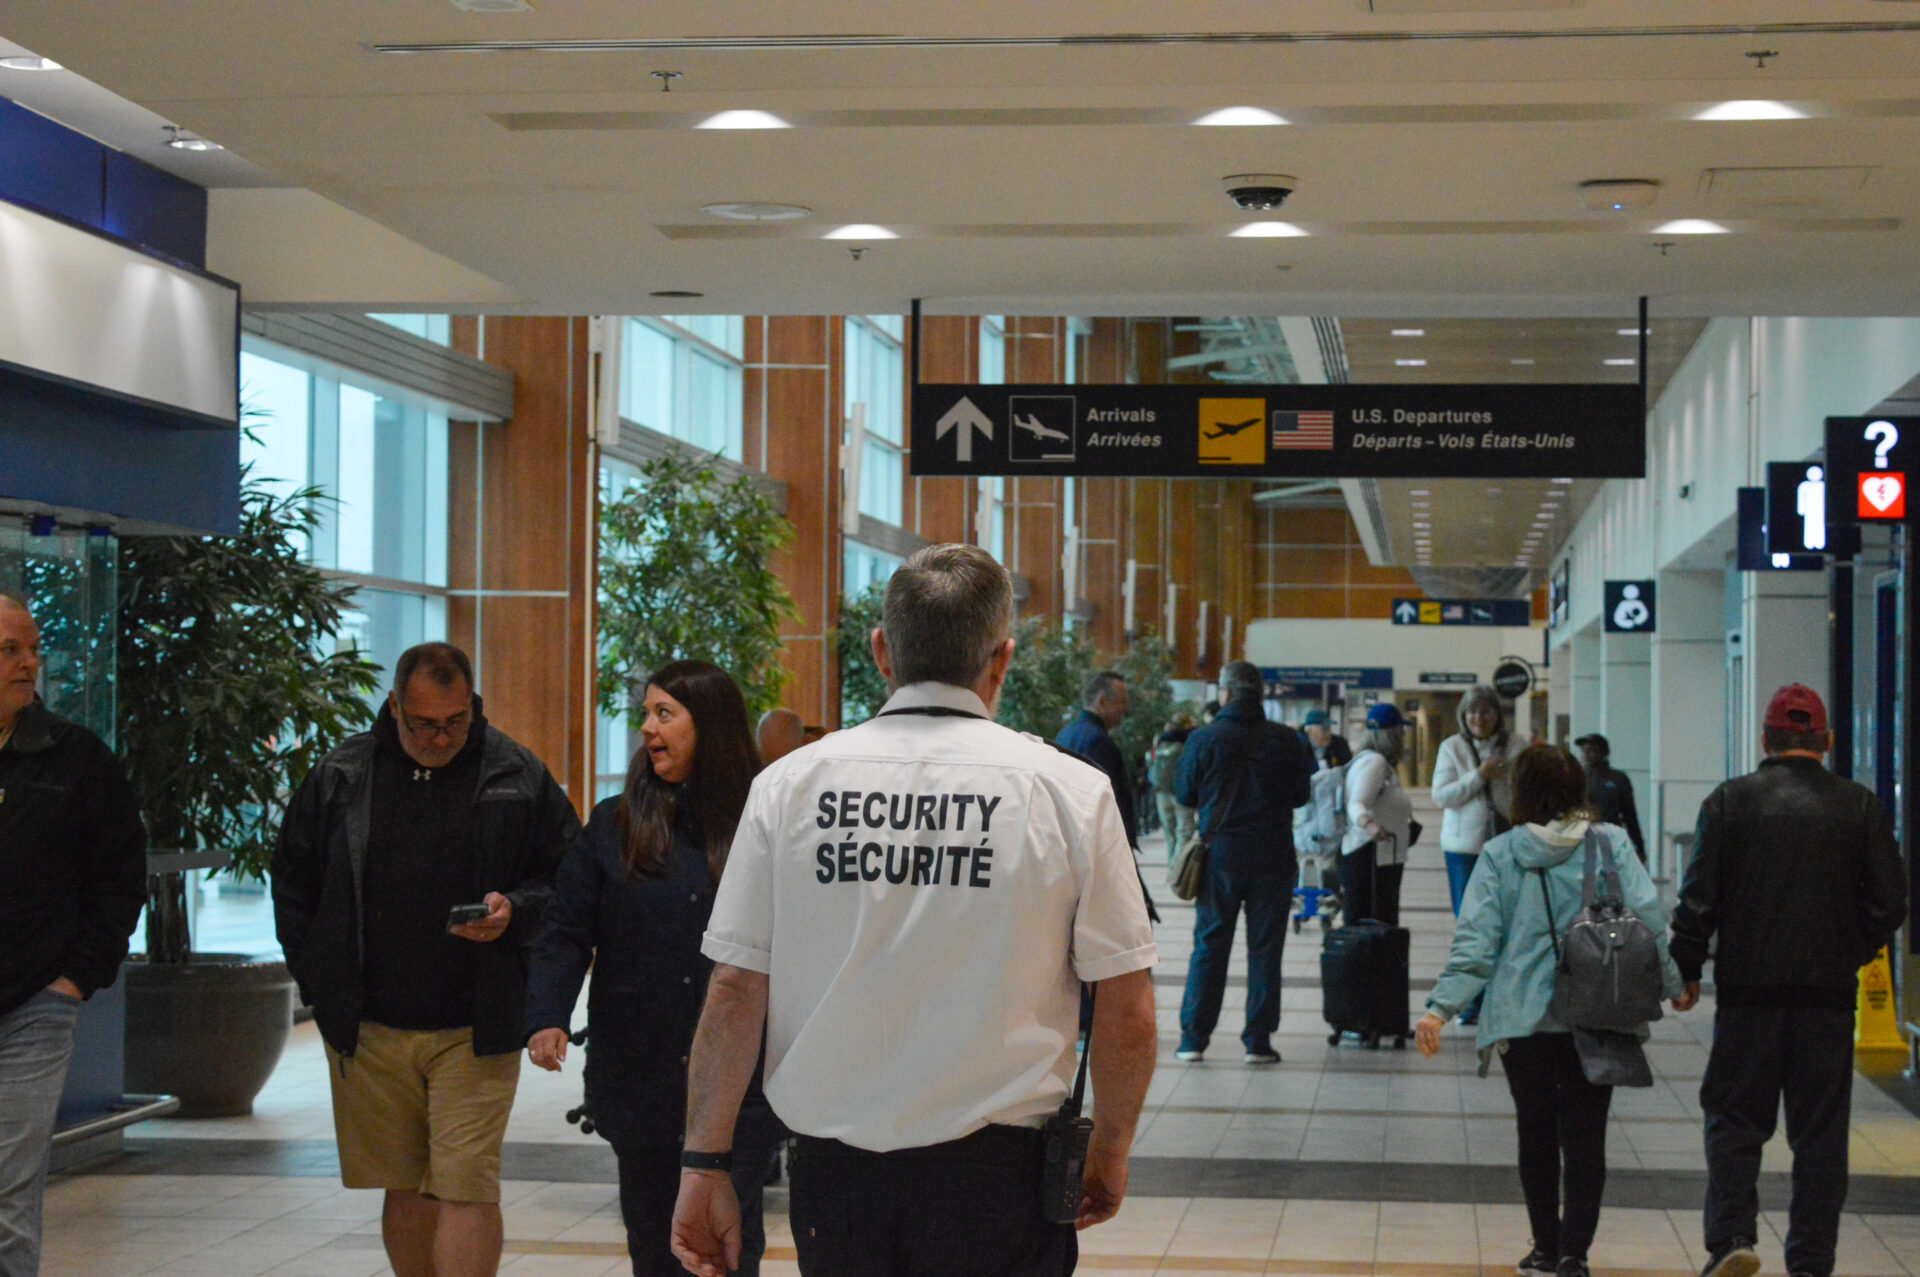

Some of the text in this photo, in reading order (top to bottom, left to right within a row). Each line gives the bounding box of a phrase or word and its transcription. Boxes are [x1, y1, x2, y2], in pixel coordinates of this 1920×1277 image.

[1086, 408, 1156, 422] Arrivals
[1352, 409, 1493, 426] U.S. Departures
[1086, 432, 1162, 447] Arrivées
[1352, 434, 1422, 451] Départs
[1438, 434, 1475, 448] Vols
[1481, 431, 1576, 449] États-Unis
[816, 791, 1002, 832] SECURITY
[816, 832, 994, 888] SÉCURITÉ
